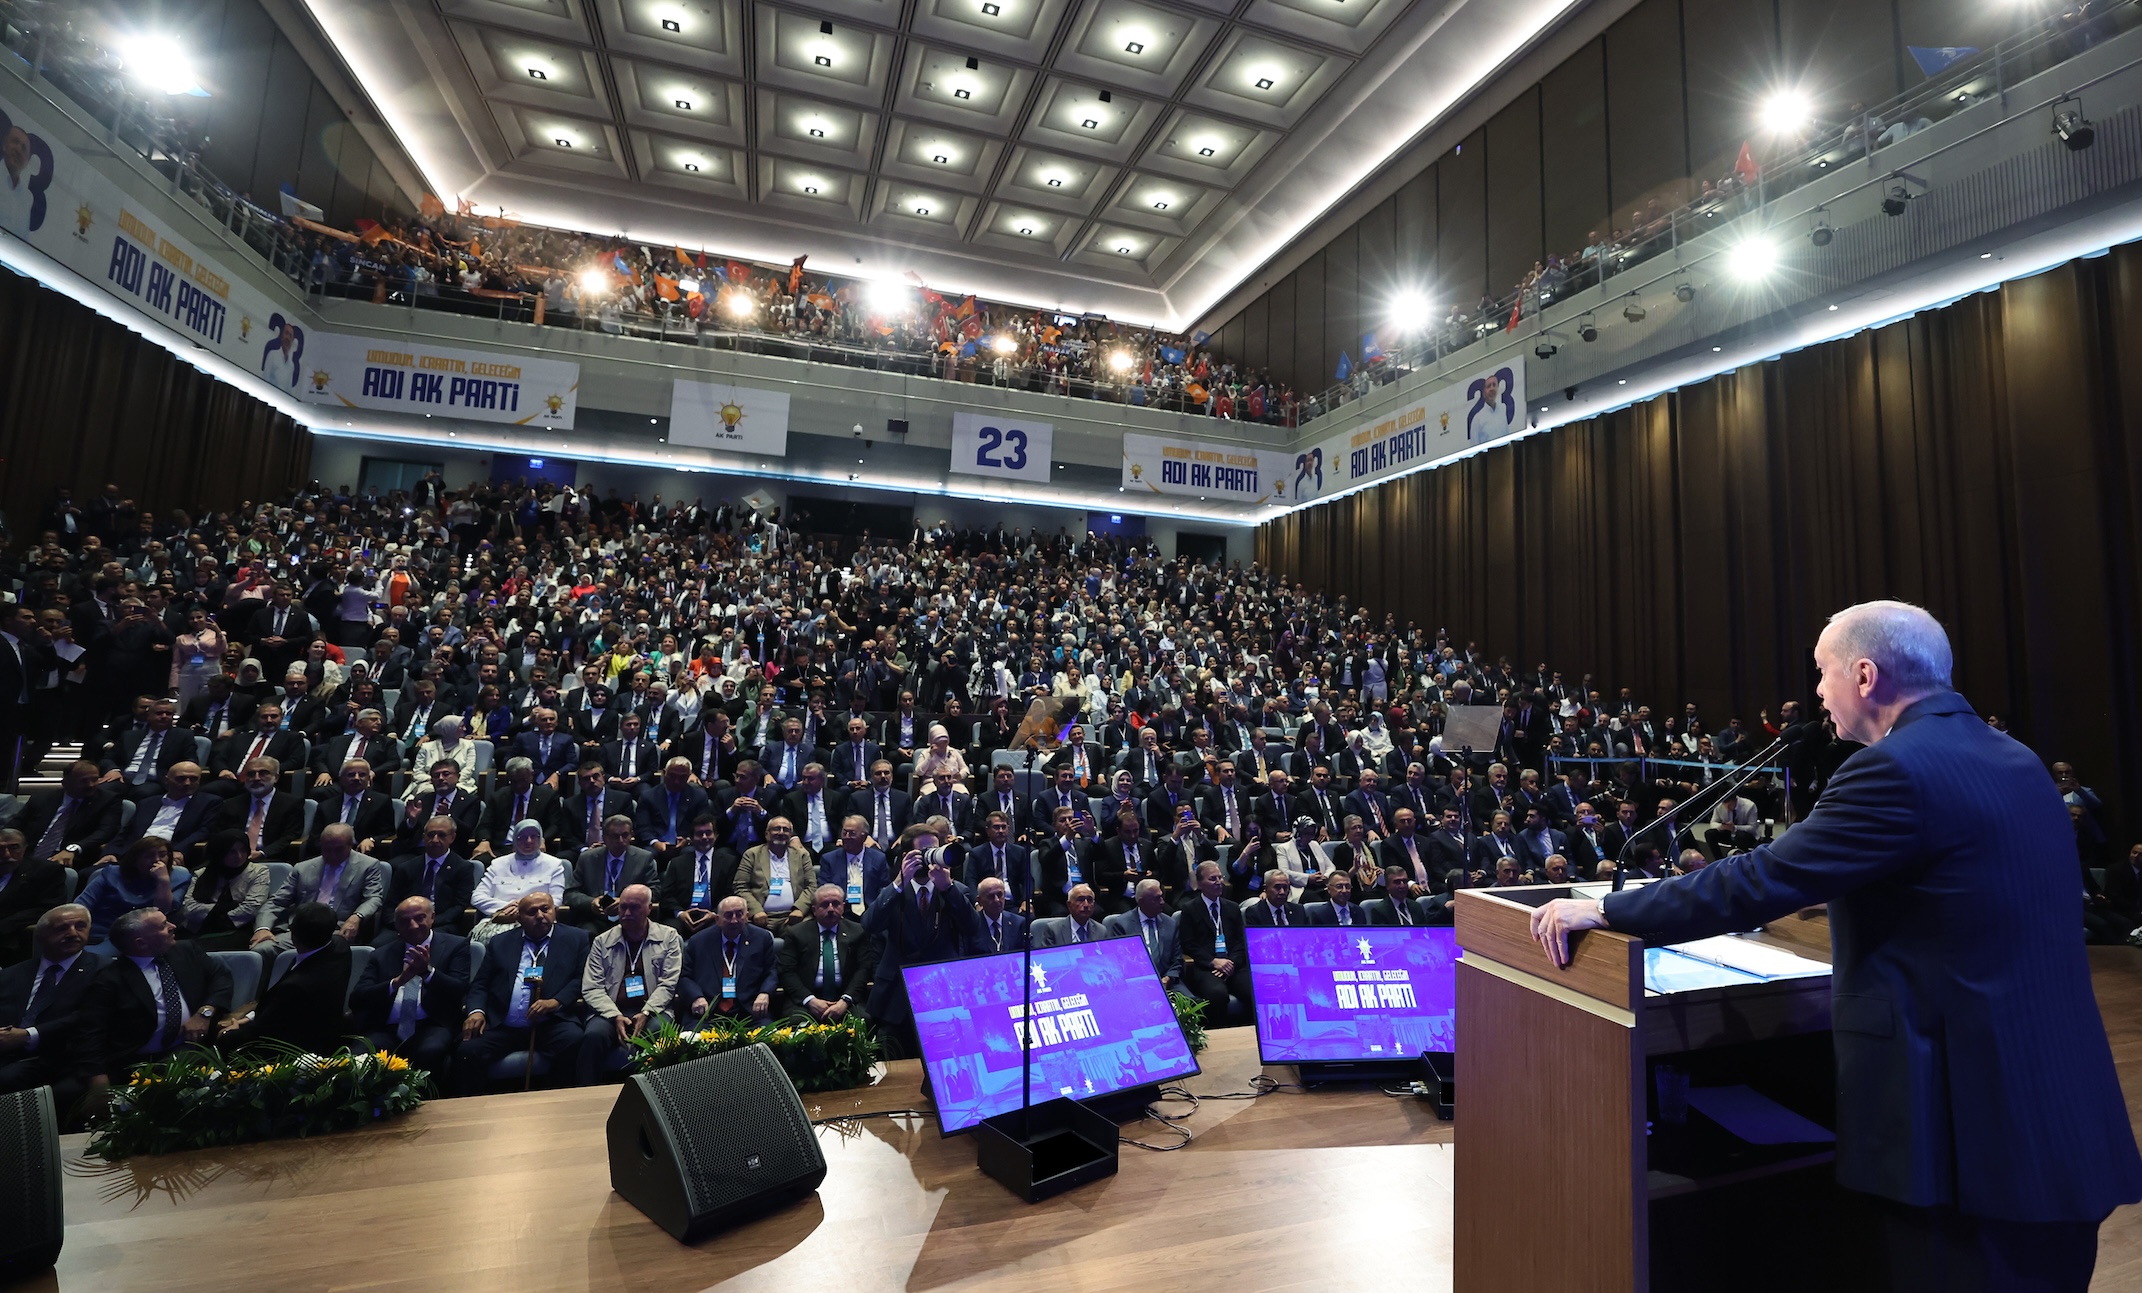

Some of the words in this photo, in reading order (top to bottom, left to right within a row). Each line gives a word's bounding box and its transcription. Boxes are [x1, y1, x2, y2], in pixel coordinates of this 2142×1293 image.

[108, 235, 146, 296] ADI
[146, 261, 175, 314] AK
[362, 367, 405, 400] ADI
[410, 372, 444, 404] AK
[976, 426, 1028, 470] 23
[1351, 447, 1369, 479] ADI
[1371, 440, 1387, 472] AK
[1162, 460, 1187, 485] ADI
[1191, 463, 1211, 488] AK
[1335, 984, 1359, 1009] ADI
[1358, 984, 1379, 1009] AK
[1037, 1016, 1063, 1046] AK
